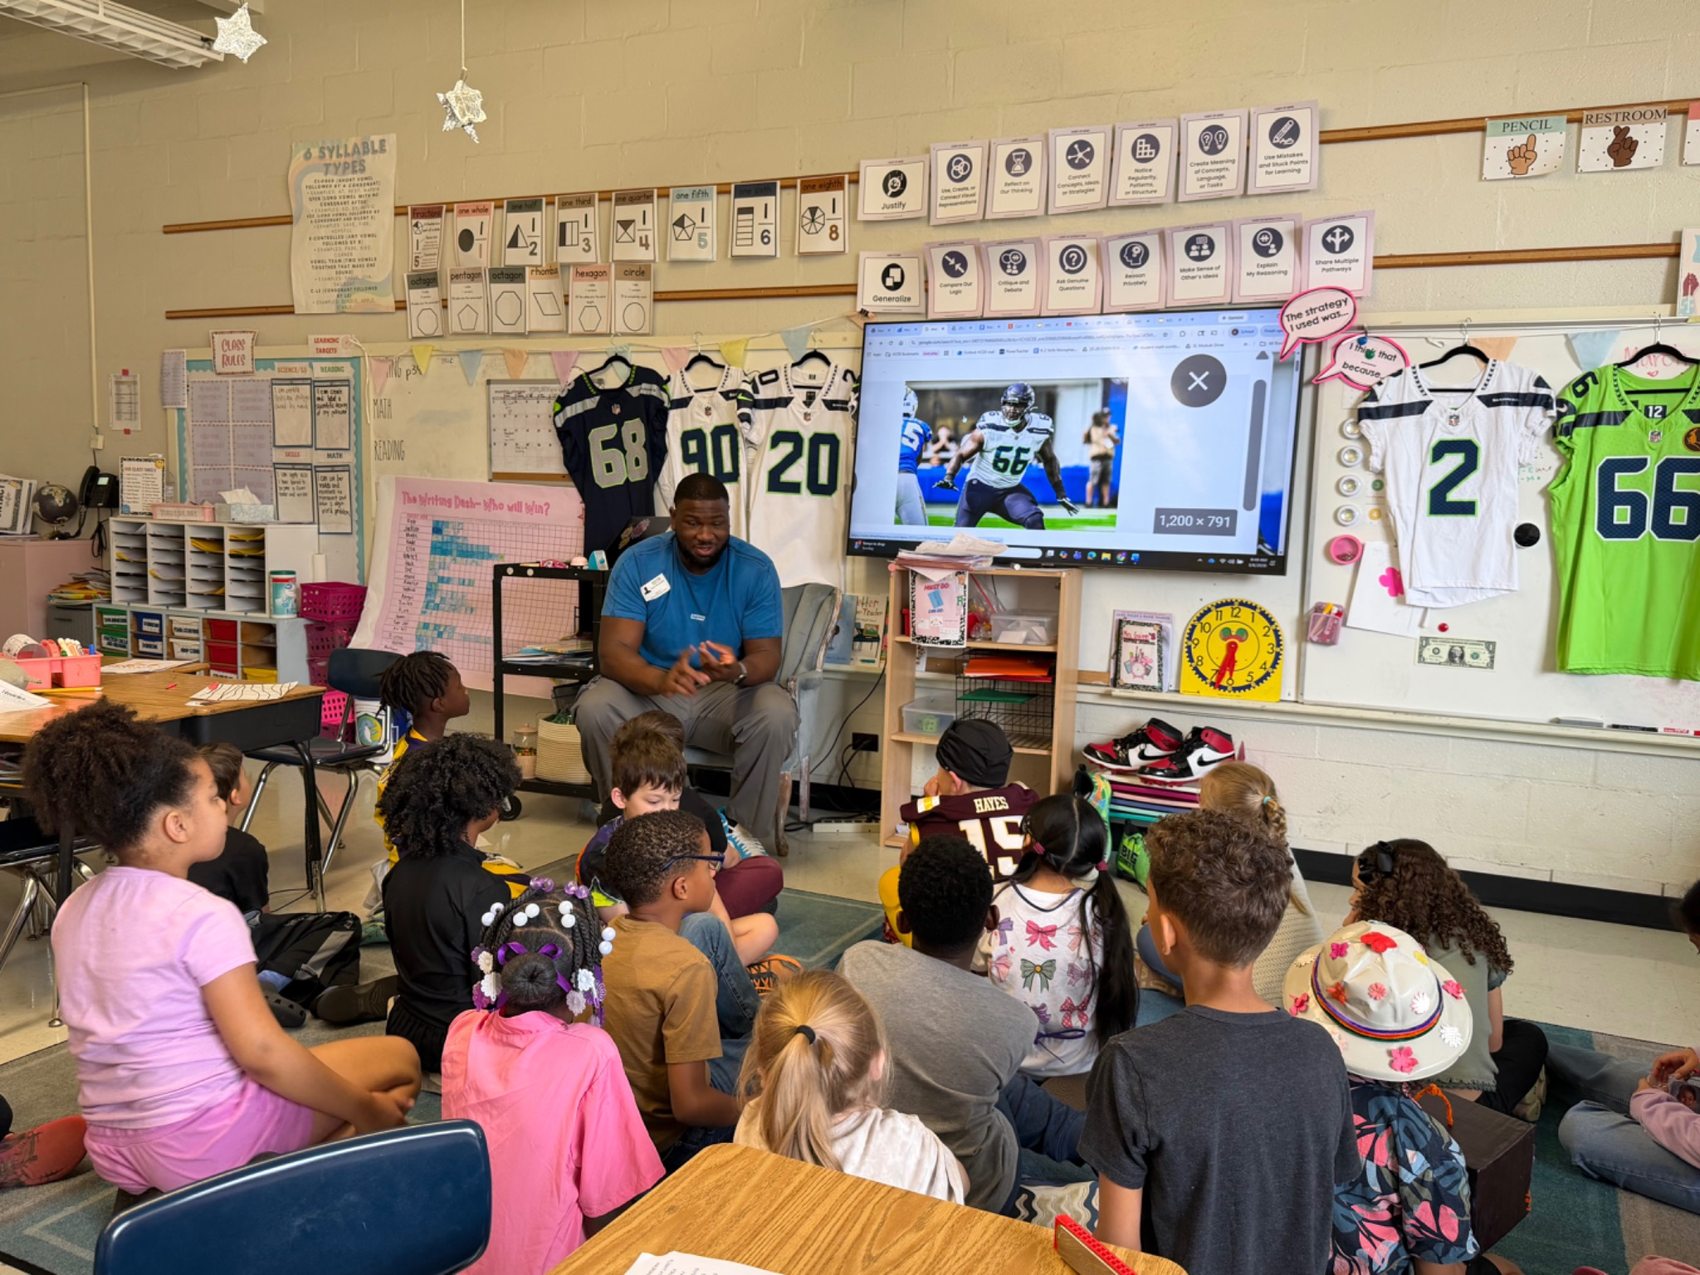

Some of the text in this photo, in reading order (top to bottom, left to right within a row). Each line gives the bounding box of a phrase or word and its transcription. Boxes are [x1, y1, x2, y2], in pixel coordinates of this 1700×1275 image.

[1585, 108, 1669, 125] RESTROOM
[1502, 119, 1553, 133] PENCIL
[303, 139, 387, 160] 6 SYLLABLE
[1210, 158, 1236, 166] Meaning
[1264, 152, 1304, 161] Use Mistakes
[1289, 158, 1309, 166] Points
[324, 159, 366, 176] TYPES
[1201, 166, 1230, 175] Concepts,
[1275, 167, 1301, 176] Learning
[1068, 173, 1091, 181] Connect
[1196, 175, 1227, 183] Language,
[803, 180, 842, 191] one eighth
[1011, 187, 1033, 195] Thinking
[1057, 181, 1084, 189] Concepts,
[628, 192, 653, 202] quarter
[676, 188, 709, 200] one fifth
[1069, 188, 1096, 196] Strategies
[575, 196, 591, 205] third
[832, 197, 836, 214] 1
[881, 200, 906, 211] Justify
[938, 199, 977, 207] Representations
[471, 206, 488, 214] whole
[701, 207, 705, 223] 1
[764, 203, 768, 219] 1
[584, 213, 588, 228] 1
[643, 210, 646, 225] 1
[760, 229, 771, 245] 6
[829, 224, 839, 241] 8
[582, 237, 592, 253] 3
[639, 234, 649, 251] 4
[697, 232, 708, 249] 5
[529, 241, 538, 256] 2
[414, 256, 420, 268] 5
[1256, 261, 1279, 269] Explain
[1315, 256, 1360, 266] Share Multiple
[450, 271, 482, 281] pentagon
[492, 270, 524, 281] octagon
[575, 268, 608, 280] hexagon
[623, 267, 645, 277] circle
[1246, 268, 1288, 278] My Reasoning
[1321, 266, 1352, 274] Pathways
[939, 281, 963, 289] Compare
[998, 279, 1018, 288] Critique
[1123, 279, 1147, 287] Privately
[949, 288, 962, 296] Logic
[872, 294, 912, 303] Generalize
[1285, 297, 1349, 322] The strategy
[1290, 310, 1349, 332] I used was...
[221, 338, 246, 352] CLASS
[1349, 342, 1397, 362] I thi that
[221, 353, 246, 368] RULES
[1342, 361, 1381, 378] because
[373, 398, 393, 419] MATH
[1648, 405, 1663, 418] 12
[374, 439, 405, 461] READING
[588, 417, 649, 489] 68
[680, 423, 740, 484] 90
[766, 429, 840, 497] 20
[992, 446, 1031, 476] 66
[1426, 438, 1481, 518] 2
[401, 491, 417, 506] The
[418, 492, 452, 509] Writing
[483, 497, 504, 512] Who
[507, 500, 523, 513] will
[525, 500, 550, 516] Win?
[1595, 455, 1700, 542] 66
[1160, 514, 1193, 528] 1,200
[1207, 515, 1230, 528] 791
[1215, 610, 1223, 622] 11
[1231, 606, 1241, 618] 12
[1250, 612, 1255, 622] 1
[1200, 622, 1212, 634] 10
[1263, 626, 1271, 637] 2
[1192, 638, 1199, 649] 9
[1267, 643, 1275, 654] 3
[1196, 655, 1204, 666] 8
[1259, 660, 1268, 671] 4
[1211, 669, 1220, 682] 7
[1246, 671, 1254, 683] 5
[973, 796, 1009, 813] HAYES
[958, 815, 1026, 880] 15
[1121, 844, 1138, 865] BIG
